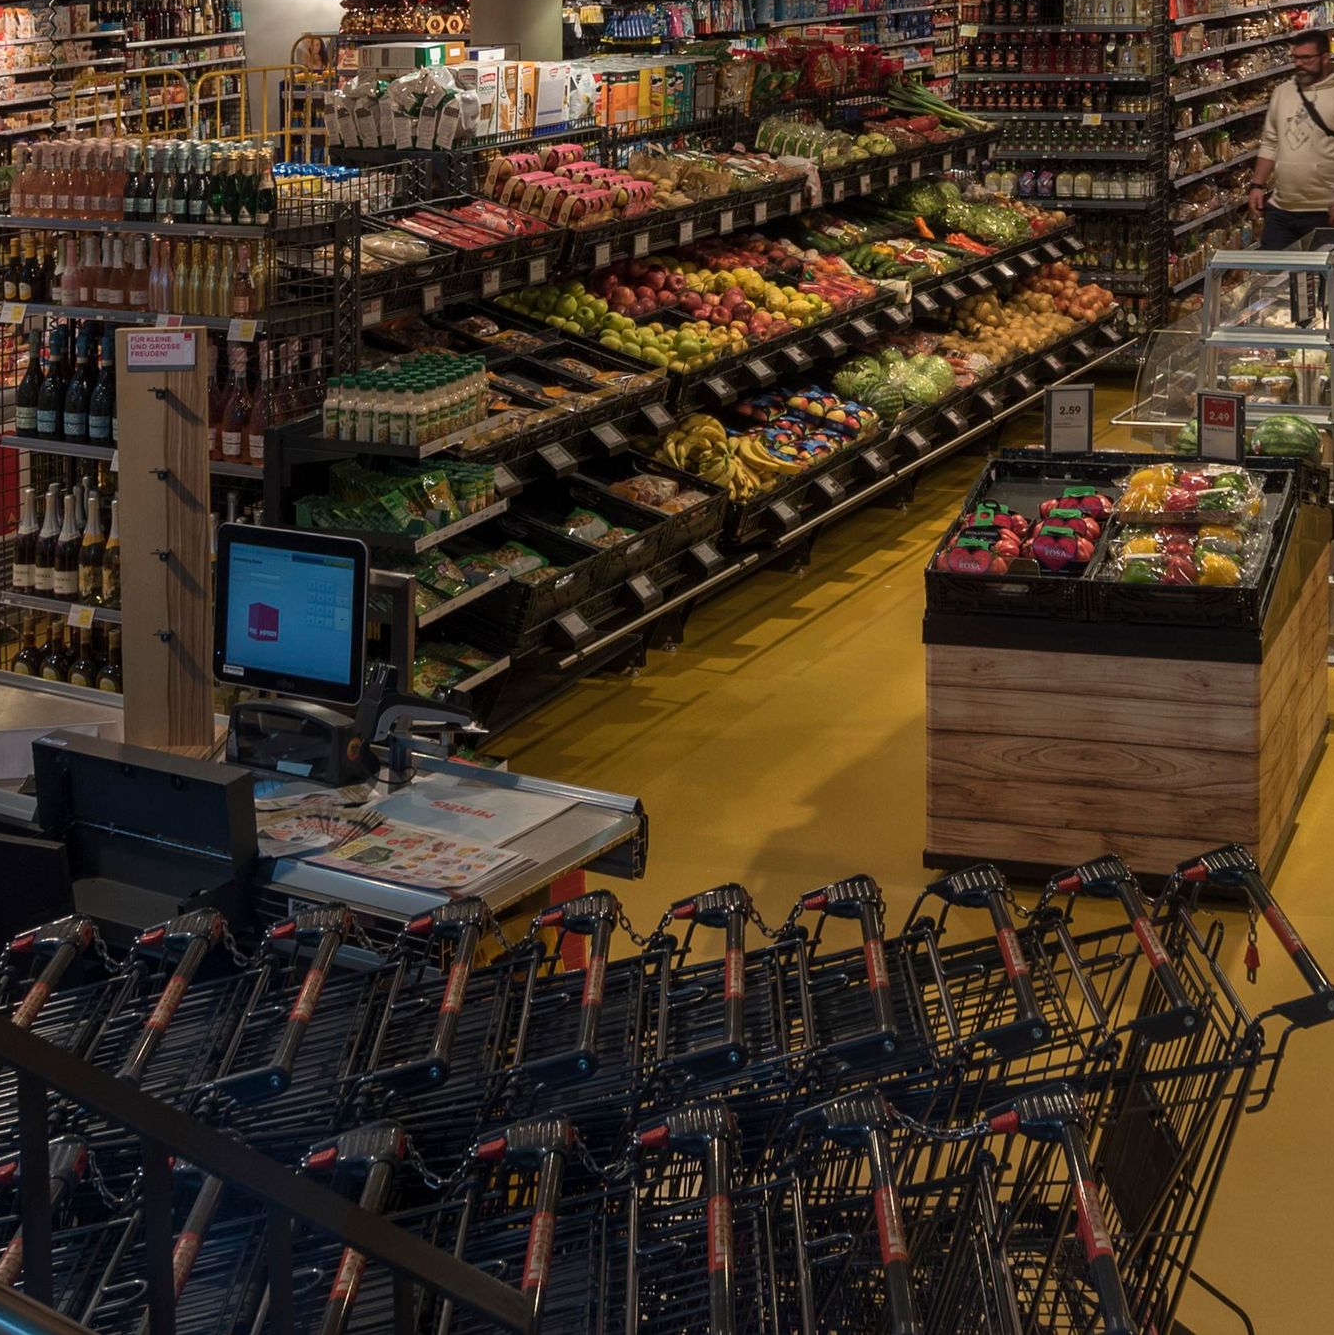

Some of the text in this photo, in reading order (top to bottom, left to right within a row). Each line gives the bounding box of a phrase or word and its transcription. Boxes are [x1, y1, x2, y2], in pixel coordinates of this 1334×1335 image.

[130, 334, 172, 344] FÜR KLEINE
[130, 343, 181, 351] UND GROSSE
[130, 350, 168, 359] FREUDEN!
[1059, 405, 1081, 415] 2.59
[1209, 411, 1230, 423] 2.49
[1044, 546, 1067, 558] ROSA
[958, 560, 981, 573] ROSA
